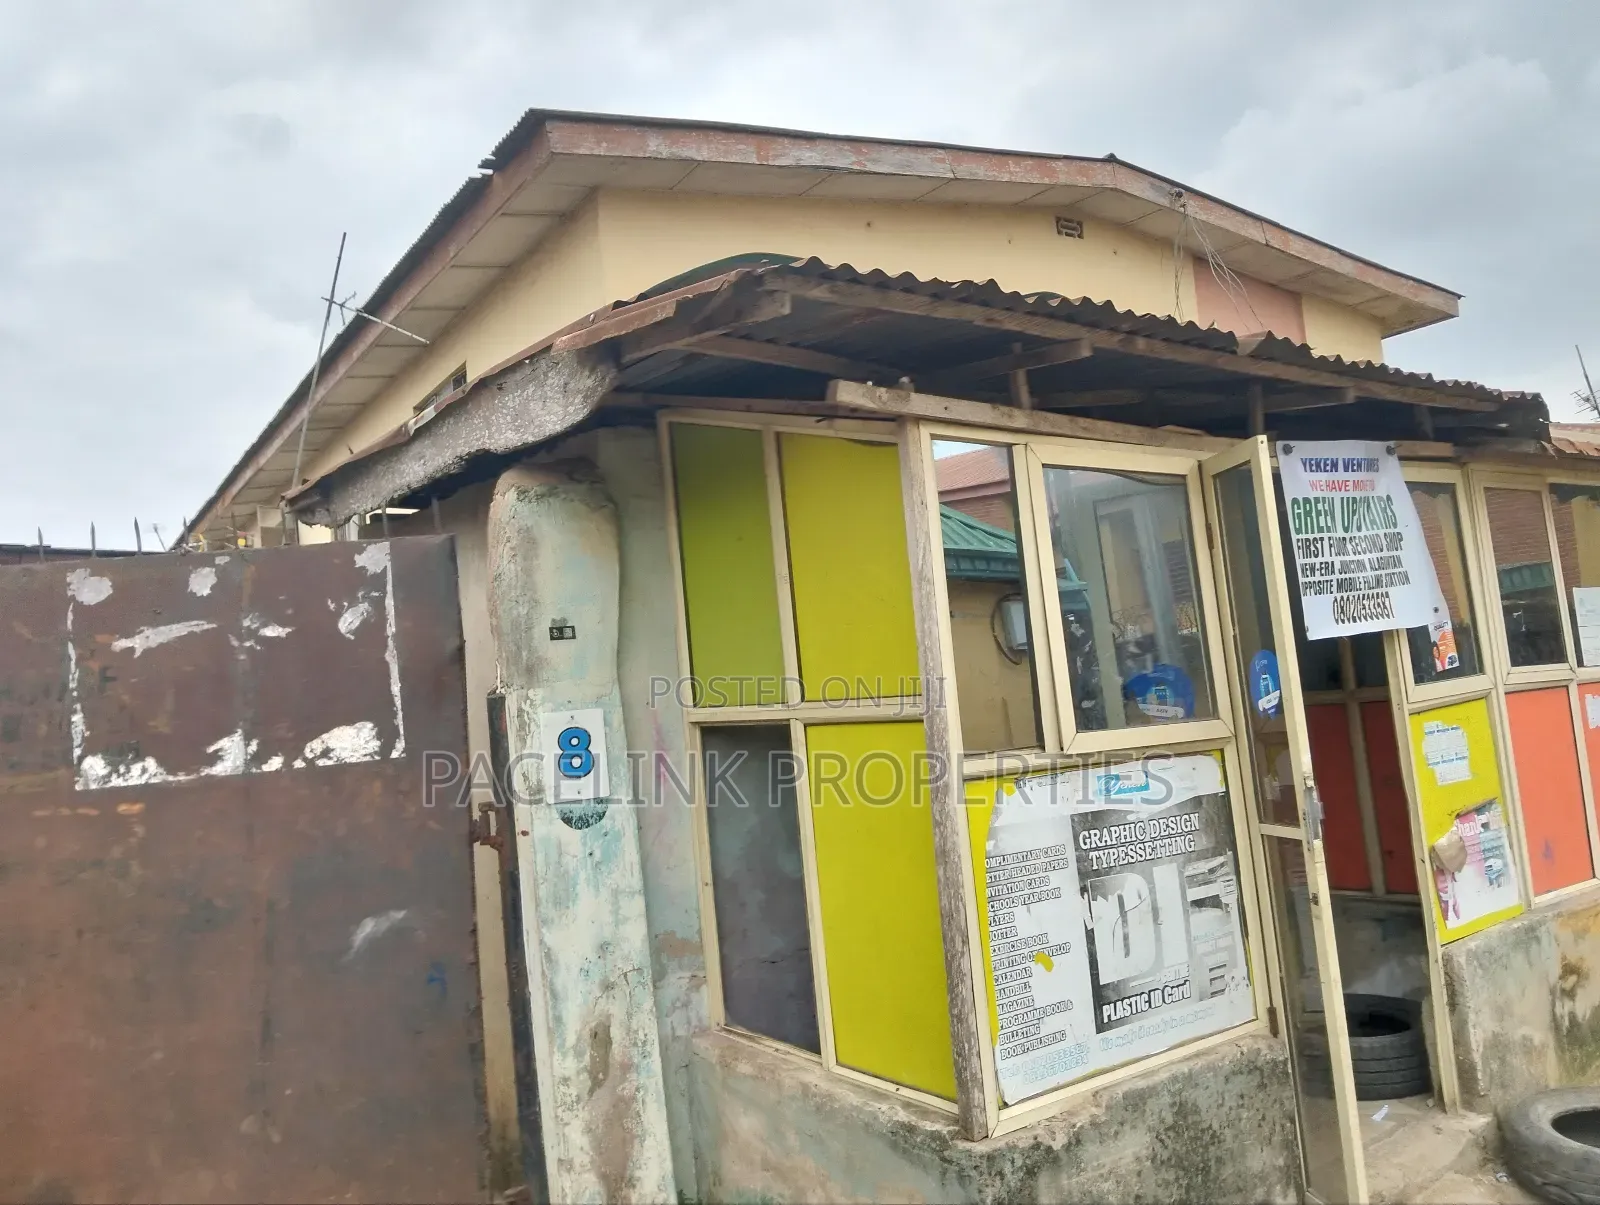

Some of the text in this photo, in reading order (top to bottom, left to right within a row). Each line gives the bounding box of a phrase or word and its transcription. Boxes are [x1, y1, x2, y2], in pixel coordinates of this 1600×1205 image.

[1301, 457, 1380, 473] YEKEN VENTURES
[1309, 480, 1324, 492] WE
[1326, 480, 1350, 492] HAVE
[1291, 494, 1398, 536] GREEN UPSTAIRS
[1295, 532, 1403, 560] FIRST FLOOR SECOND SHOP
[1300, 561, 1335, 578] NEW-ERA
[1338, 558, 1368, 575] JUNCTION
[1301, 571, 1411, 597] OPPOSITE MOBILE FILLING STATION
[1332, 591, 1395, 625] 08020533587
[557, 727, 595, 778] 8
[1078, 811, 1201, 850] GRAPHIC DESIGN
[984, 844, 1066, 868] OMPLIMENTARY CARDS
[1088, 834, 1196, 871] TYPESSETTING
[985, 858, 1068, 883] ETTER HEADED PAPERS
[1026, 875, 1050, 890] CARDS
[988, 887, 1061, 912] CHOOLS YEAR BOOK
[990, 932, 1049, 957] EXERCISE BOOK
[991, 952, 1026, 972] PRINTING
[993, 966, 1032, 985] CALENDAR
[995, 981, 1032, 1001] HANDBILL
[1101, 980, 1191, 1023] PLASTIC ID Card
[996, 995, 1034, 1016] MAGAZINE
[998, 999, 1074, 1030] PROGRAMME BOOK &
[998, 1023, 1041, 1046] BULLETING
[1000, 1030, 1067, 1060] BOOK PUBLISHING
